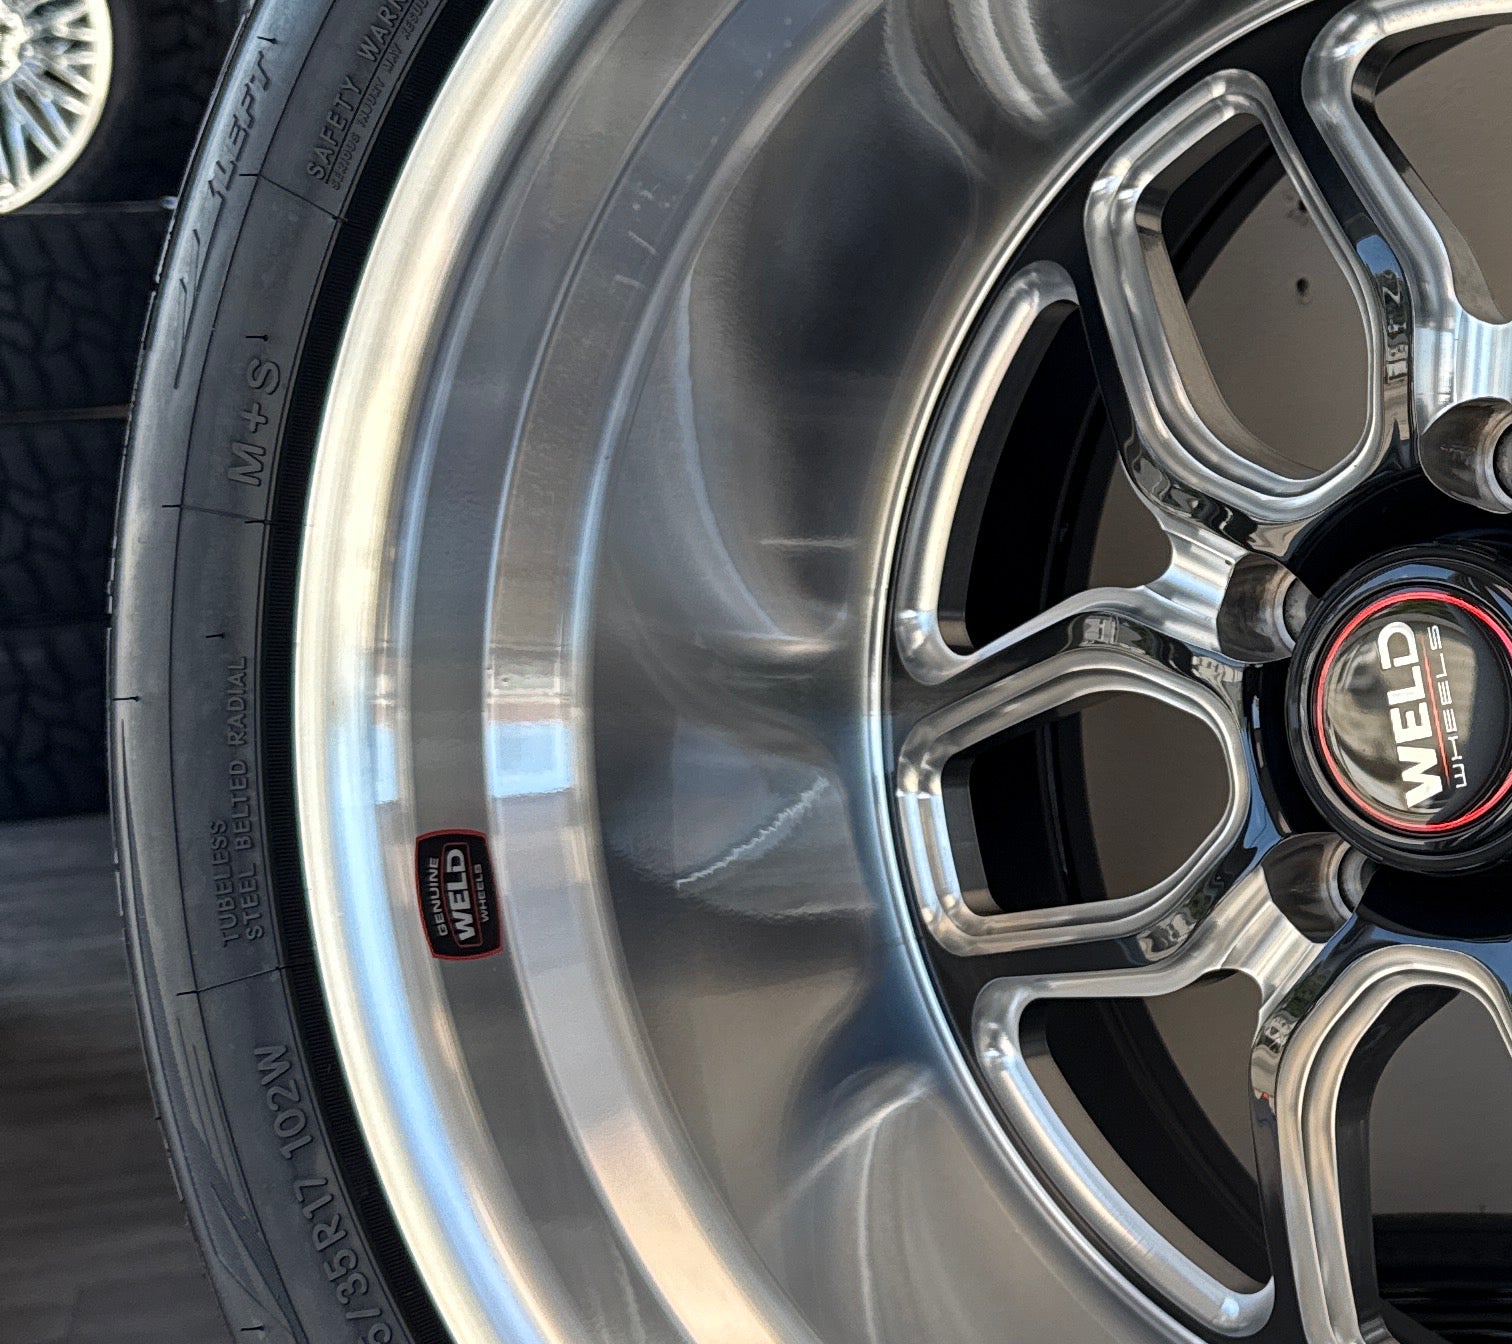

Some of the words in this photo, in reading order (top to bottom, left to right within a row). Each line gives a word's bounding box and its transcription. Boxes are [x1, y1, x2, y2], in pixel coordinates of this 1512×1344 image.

[302, 71, 365, 183] SAFETY
[225, 655, 247, 746] RADIAL
[1377, 621, 1443, 808] WELD
[1428, 624, 1468, 789] WHEELS
[227, 758, 253, 850] BELTED
[206, 817, 242, 947] TUBELESS
[234, 862, 265, 942] STEEL
[429, 857, 449, 937] GENUINE
[446, 848, 476, 941] WELD
[474, 863, 490, 923] WHEELS
[251, 1037, 315, 1161] 102W
